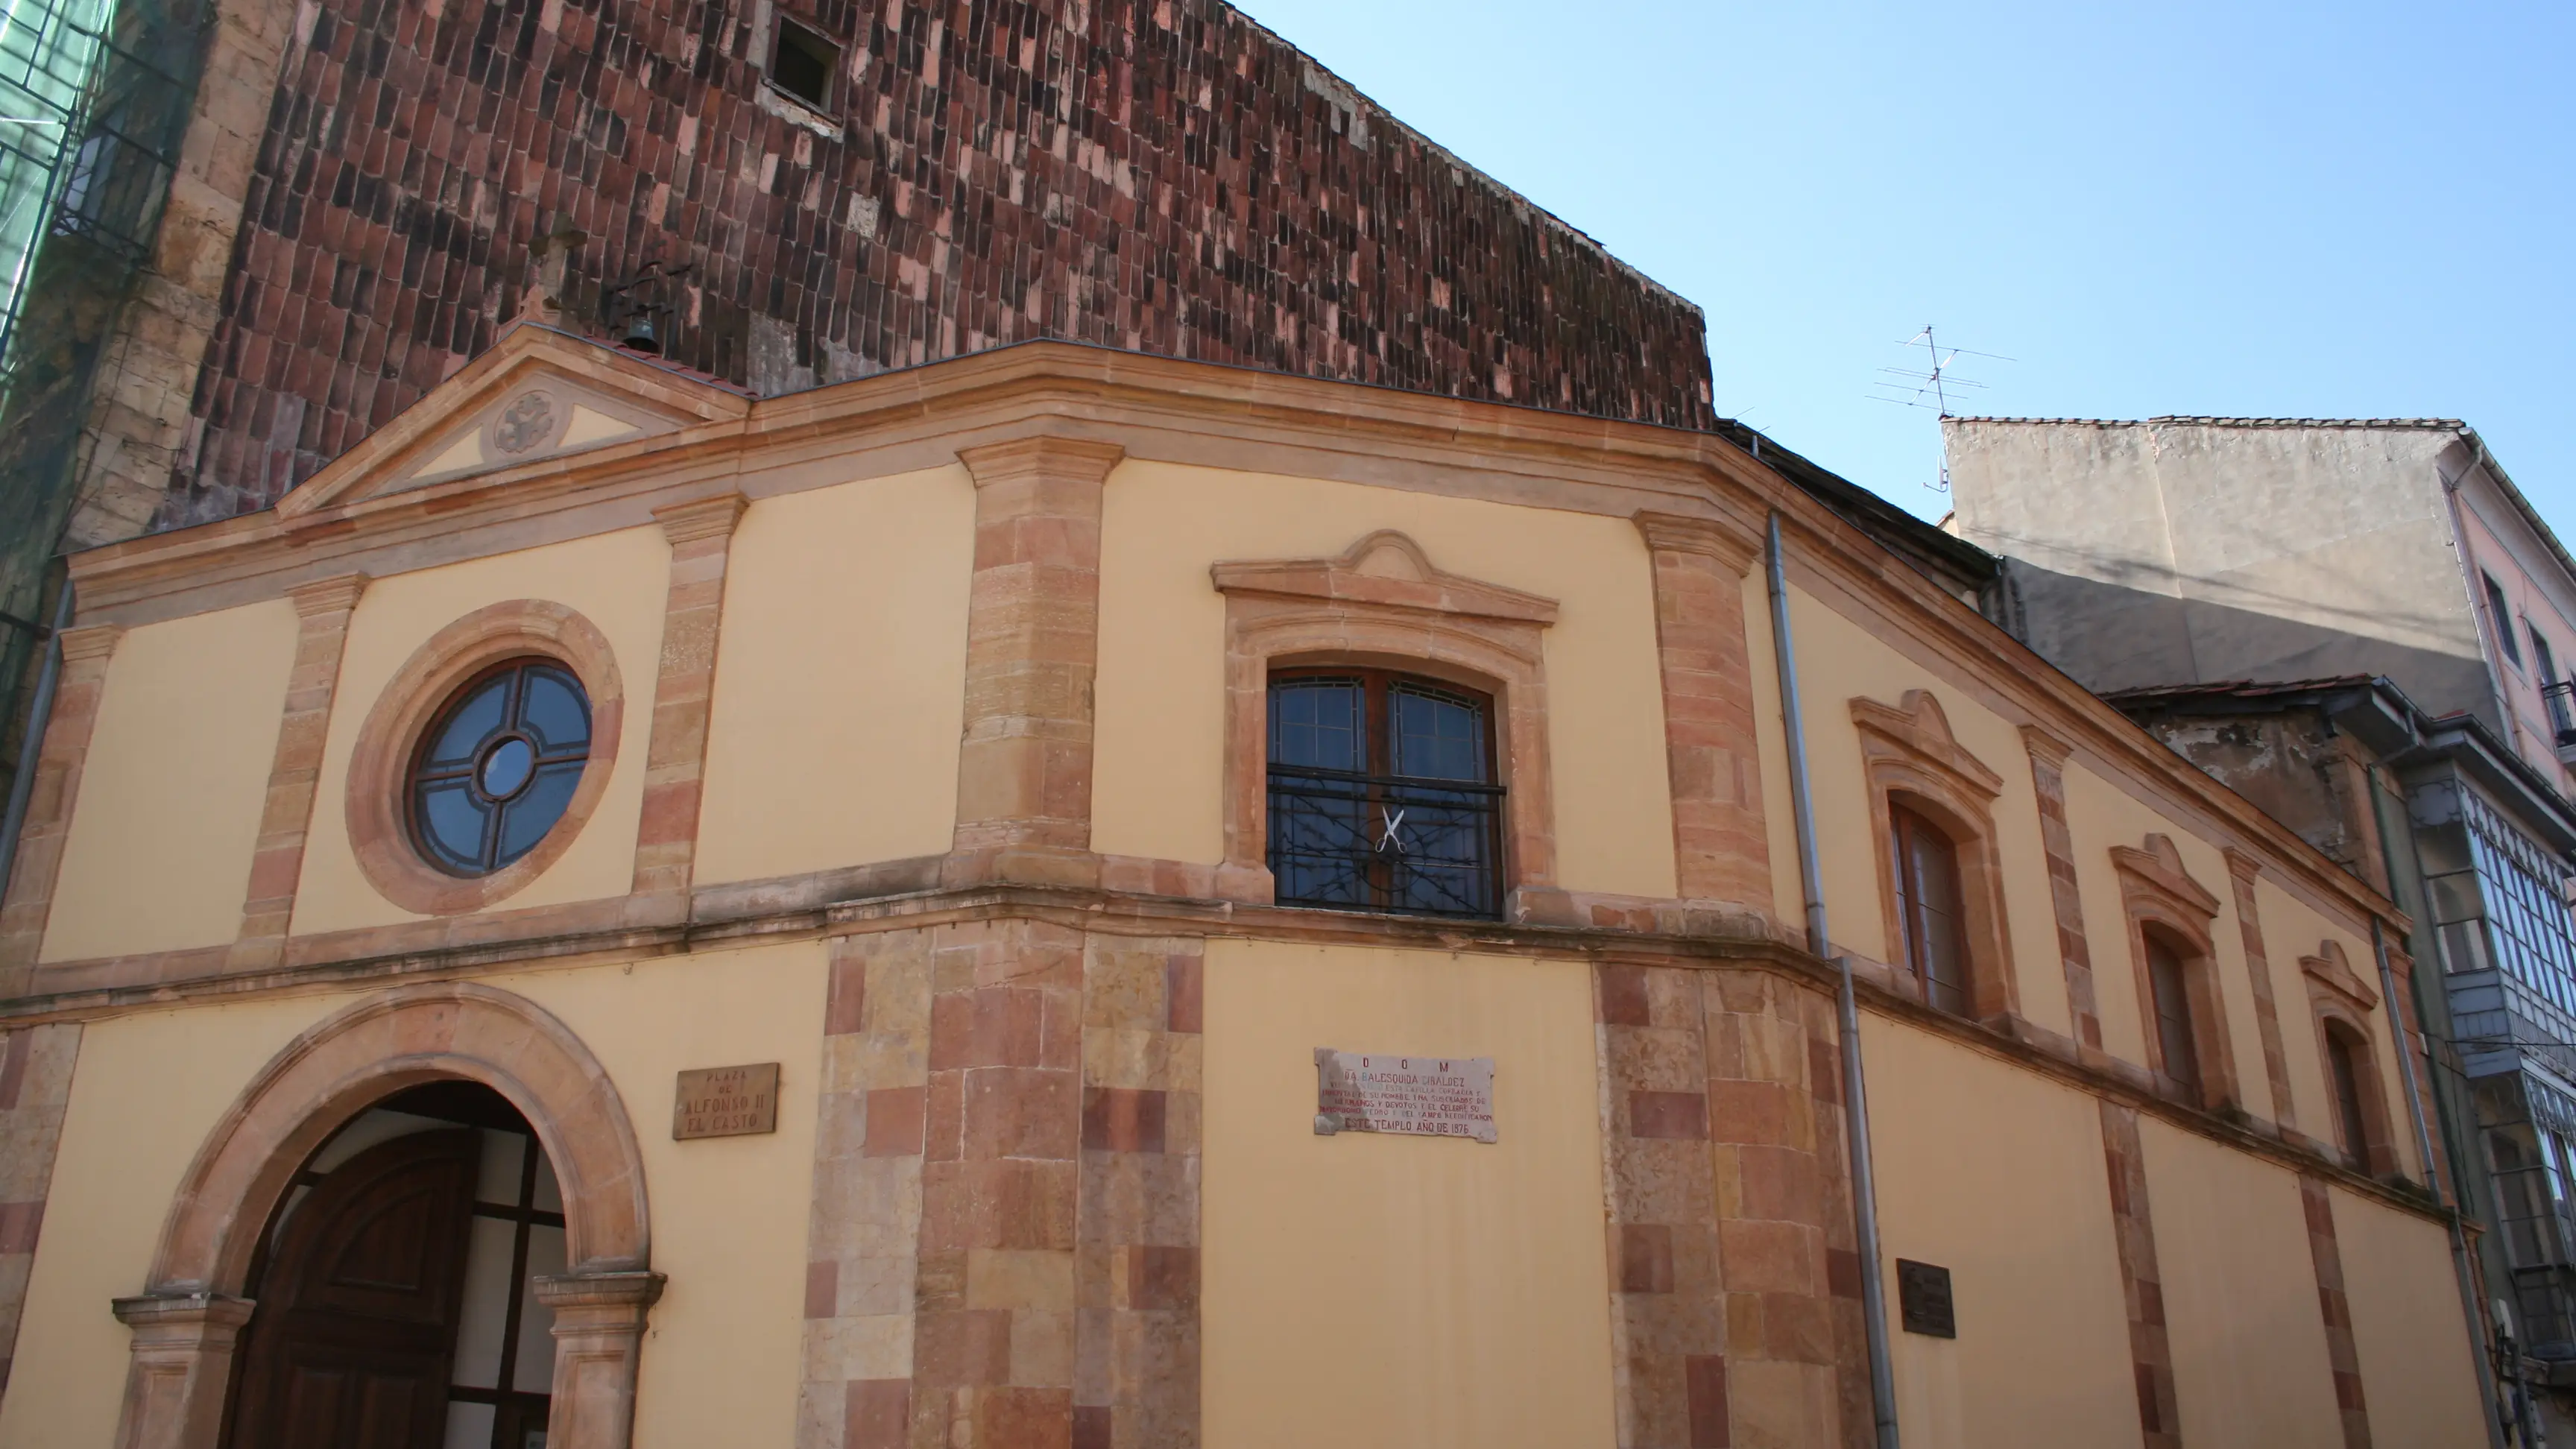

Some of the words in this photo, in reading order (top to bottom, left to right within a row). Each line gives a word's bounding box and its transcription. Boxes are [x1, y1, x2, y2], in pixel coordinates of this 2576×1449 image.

[1363, 1057, 1369, 1067] D
[1401, 1058, 1408, 1070] O
[1439, 1061, 1449, 1073] M
[707, 1070, 747, 1082] PLAZA
[1362, 1072, 1418, 1085] BALESQUIDA
[719, 1085, 732, 1094] DE
[684, 1096, 749, 1114] ALFONSO
[756, 1094, 765, 1109] II
[1385, 1101, 1416, 1109] DEVOTOS
[1471, 1105, 1480, 1113] SU
[687, 1117, 705, 1132] EL
[713, 1113, 757, 1130] CASTO
[1345, 1117, 1370, 1129] ESTE
[1374, 1119, 1412, 1131] TEMPLO
[1416, 1119, 1434, 1133] AÑO
[1437, 1123, 1448, 1133] DE
[1452, 1123, 1469, 1134] 1876
